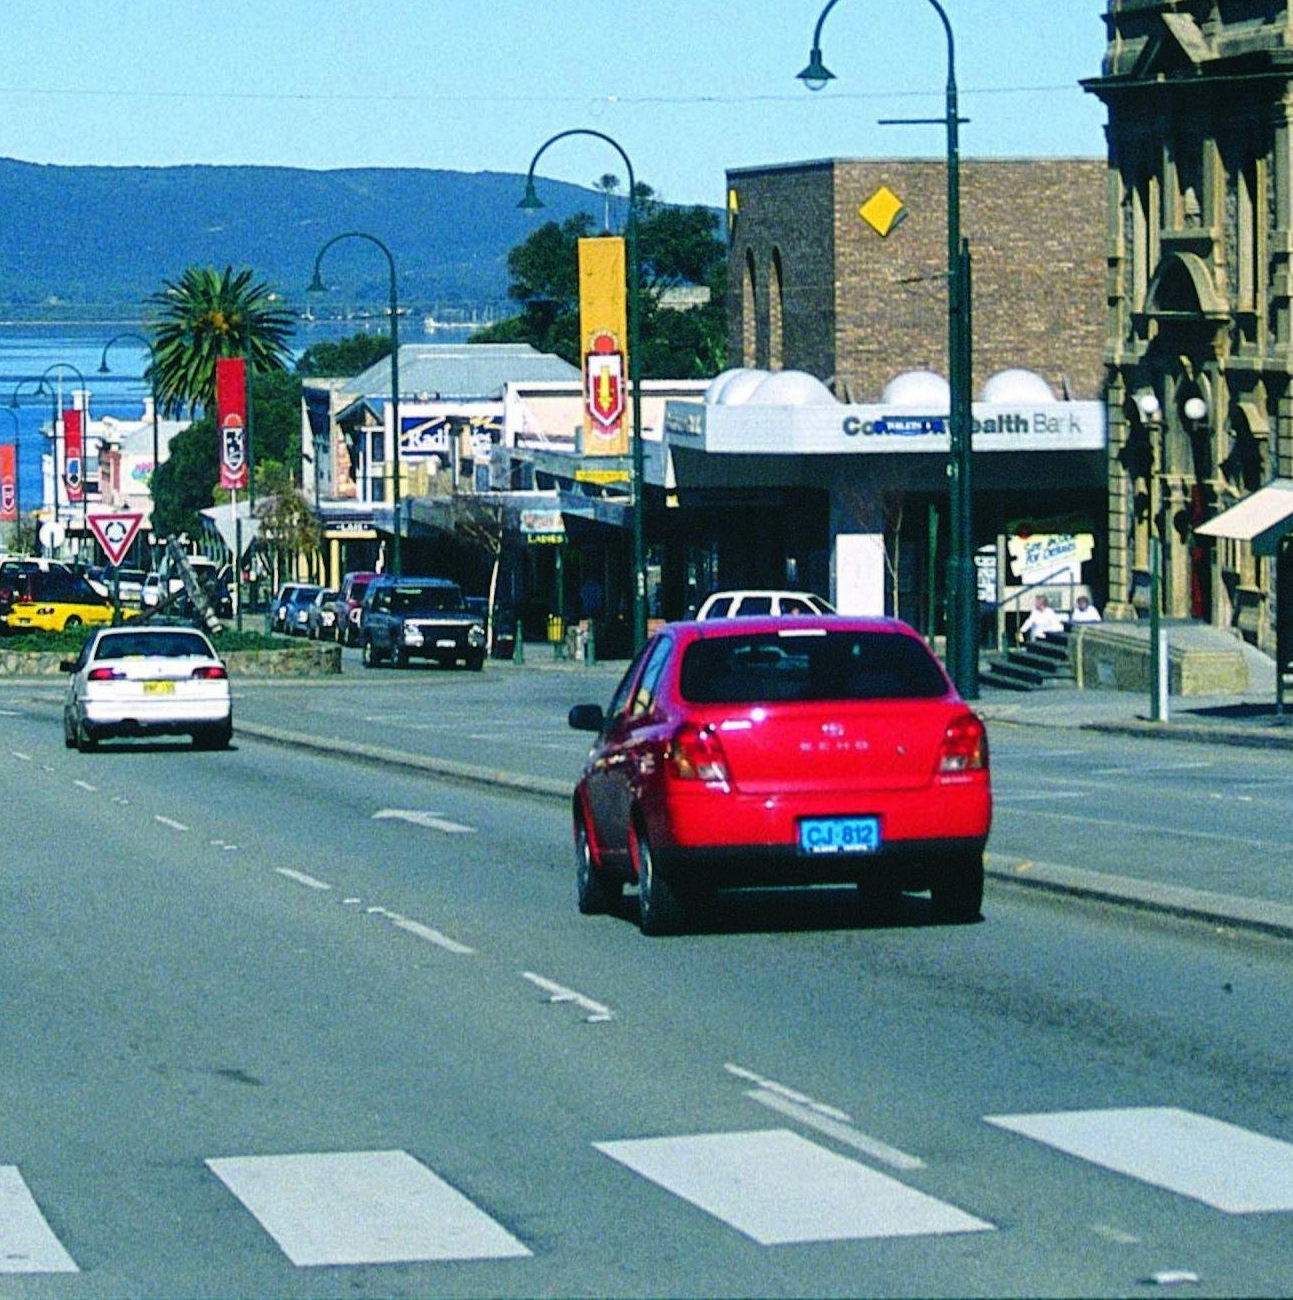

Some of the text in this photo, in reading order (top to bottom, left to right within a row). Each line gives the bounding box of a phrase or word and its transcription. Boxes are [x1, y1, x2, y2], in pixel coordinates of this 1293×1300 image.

[842, 412, 1082, 436] Coealth Bak
[799, 739, 869, 751] ECHO
[841, 824, 873, 844] 812
